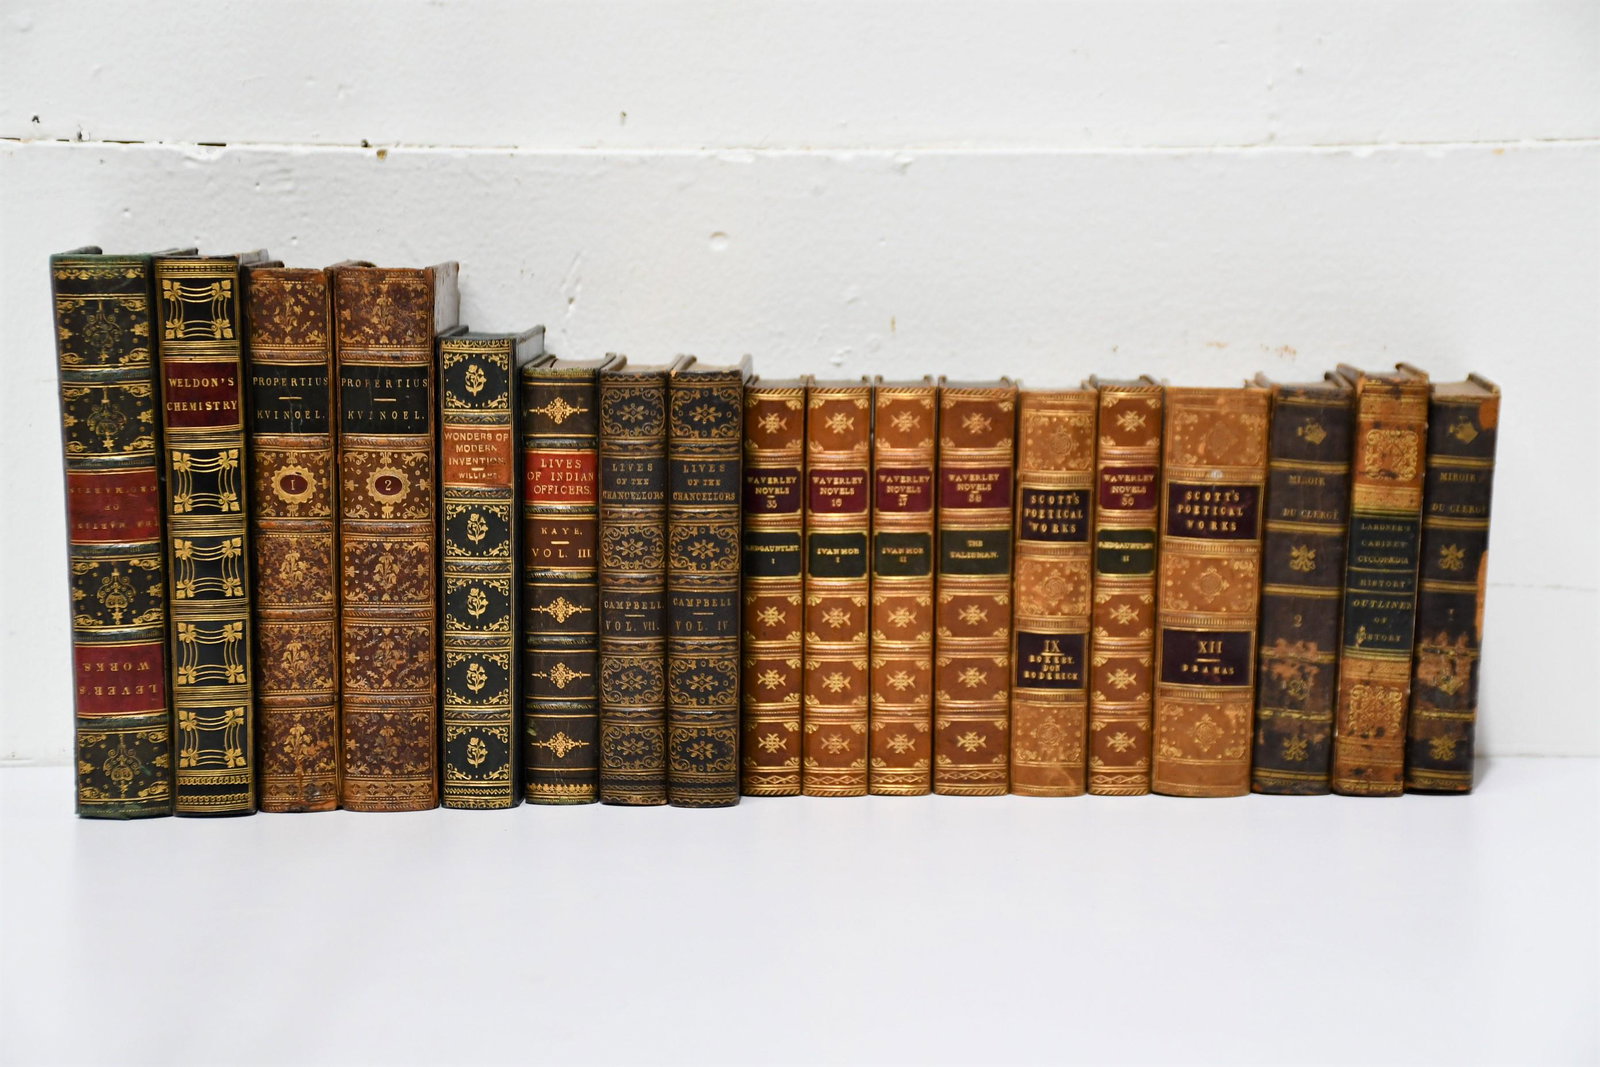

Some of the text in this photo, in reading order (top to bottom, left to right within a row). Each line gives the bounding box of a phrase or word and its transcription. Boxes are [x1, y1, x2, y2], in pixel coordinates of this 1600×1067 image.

[168, 376, 235, 388] WELDON'S
[252, 376, 329, 387] PROPERTIUS
[341, 377, 428, 388] PROPERTIUS
[166, 400, 238, 412] CHEMISTRY
[444, 432, 509, 442] WONDERS OF
[456, 444, 498, 454] MODERN
[540, 458, 582, 469] LIVES
[612, 463, 654, 472] LIVES
[682, 464, 726, 473] LIVES
[527, 472, 594, 482] OF INDIAN
[616, 478, 649, 486] OF THE
[746, 476, 798, 485] WAVERLEY
[812, 476, 864, 486] WAVERLEY
[879, 475, 931, 484] WAVERLEY
[948, 474, 1000, 482] WAVERLEY
[1104, 474, 1155, 484] WAVERLEY
[1440, 472, 1477, 483] MIROIR
[384, 480, 392, 492] 2
[533, 484, 592, 496] OFFICERS.
[755, 487, 790, 495] NOVELS
[886, 486, 922, 494] NOVELS
[957, 484, 992, 492] NOVELS
[1111, 486, 1147, 494] NOVELS
[602, 490, 664, 500] CHANCELLORS
[672, 492, 736, 501] CHANCELLORS
[820, 487, 855, 496] NOVELS
[1184, 489, 1240, 502] SCOTT'S
[1031, 492, 1080, 505] SCOTT'S
[766, 499, 778, 509] 35
[1431, 503, 1446, 513] DU
[1024, 508, 1084, 520] POETICAL
[1177, 506, 1244, 518] POETICAL
[1282, 508, 1297, 518] DU
[540, 527, 583, 536] KAYE.
[1029, 522, 1077, 534] WORKS
[1186, 521, 1238, 532] WORKS
[967, 540, 983, 548] THE
[1361, 539, 1408, 548] CABINET
[531, 548, 568, 559] VOL.
[881, 547, 925, 555] IVANHOE
[1360, 579, 1406, 588] HISTORY
[1293, 616, 1303, 628] 2
[1373, 616, 1388, 624] OF
[605, 620, 637, 632] VOL.
[1044, 640, 1061, 653] IX
[1198, 640, 1224, 654] XII
[83, 662, 151, 672] WORKS
[1042, 664, 1061, 672] DON
[1181, 664, 1235, 676] DRAMAS
[1024, 671, 1078, 680] RODERICK
